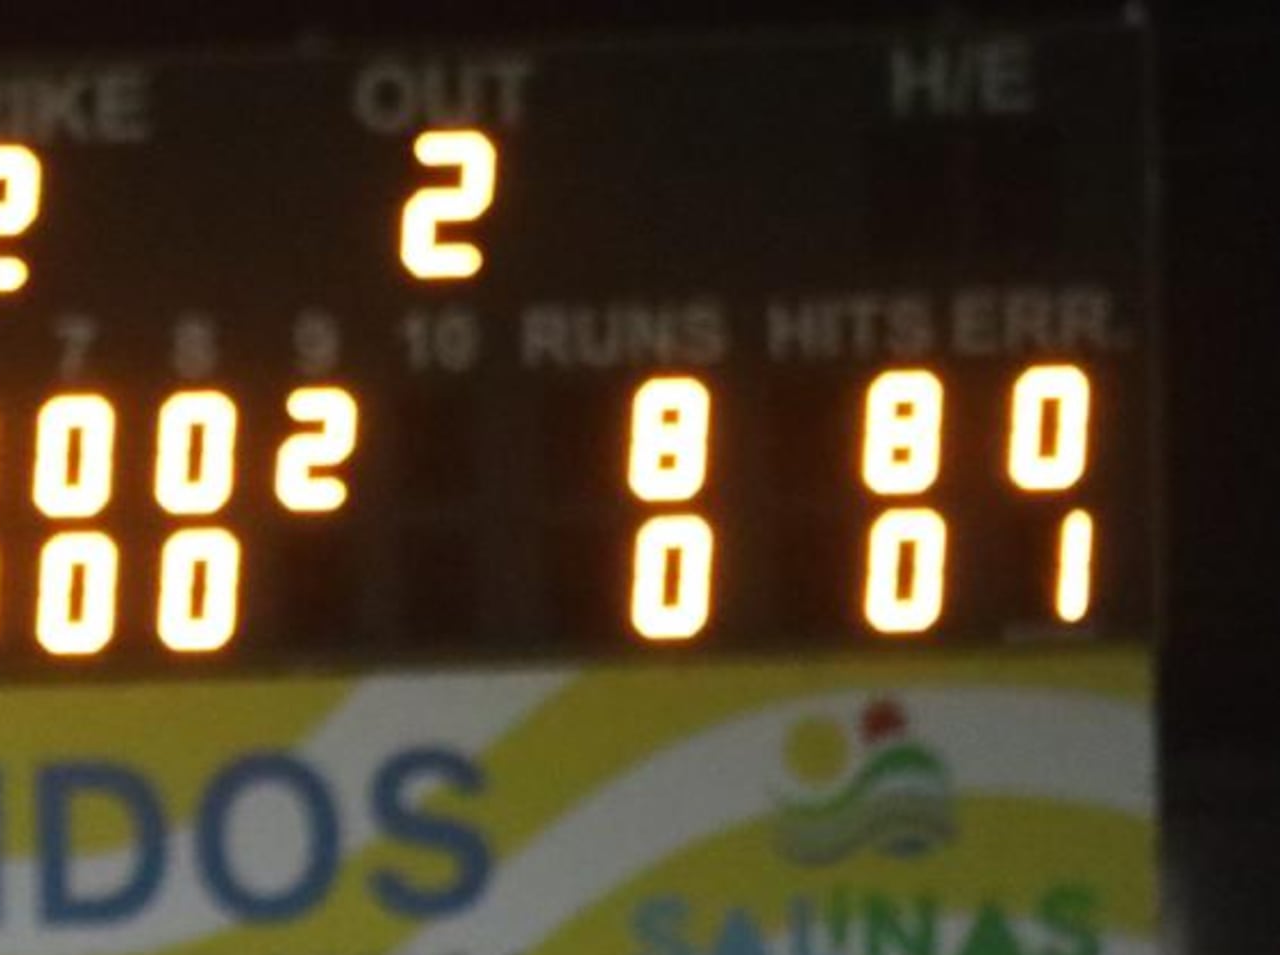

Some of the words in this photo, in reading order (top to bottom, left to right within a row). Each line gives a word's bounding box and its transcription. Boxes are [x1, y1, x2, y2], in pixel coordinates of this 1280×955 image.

[353, 58, 534, 133] OUT
[886, 38, 1037, 119] H/E
[399, 129, 497, 280] 2
[55, 315, 100, 381] 7
[170, 313, 216, 379] 8
[292, 308, 340, 373] 9
[404, 304, 482, 372] 10
[522, 301, 726, 368] RUNS
[766, 293, 936, 358] HITS
[31, 393, 117, 520] 0
[153, 389, 238, 516] 0
[274, 386, 359, 513] 2
[627, 376, 711, 503] 8
[861, 369, 944, 496] 8
[1007, 364, 1091, 492] 0
[34, 530, 120, 656] 0
[156, 526, 241, 653] 0
[630, 513, 714, 641] 0
[863, 507, 947, 634] 0
[1056, 509, 1094, 623] 1
